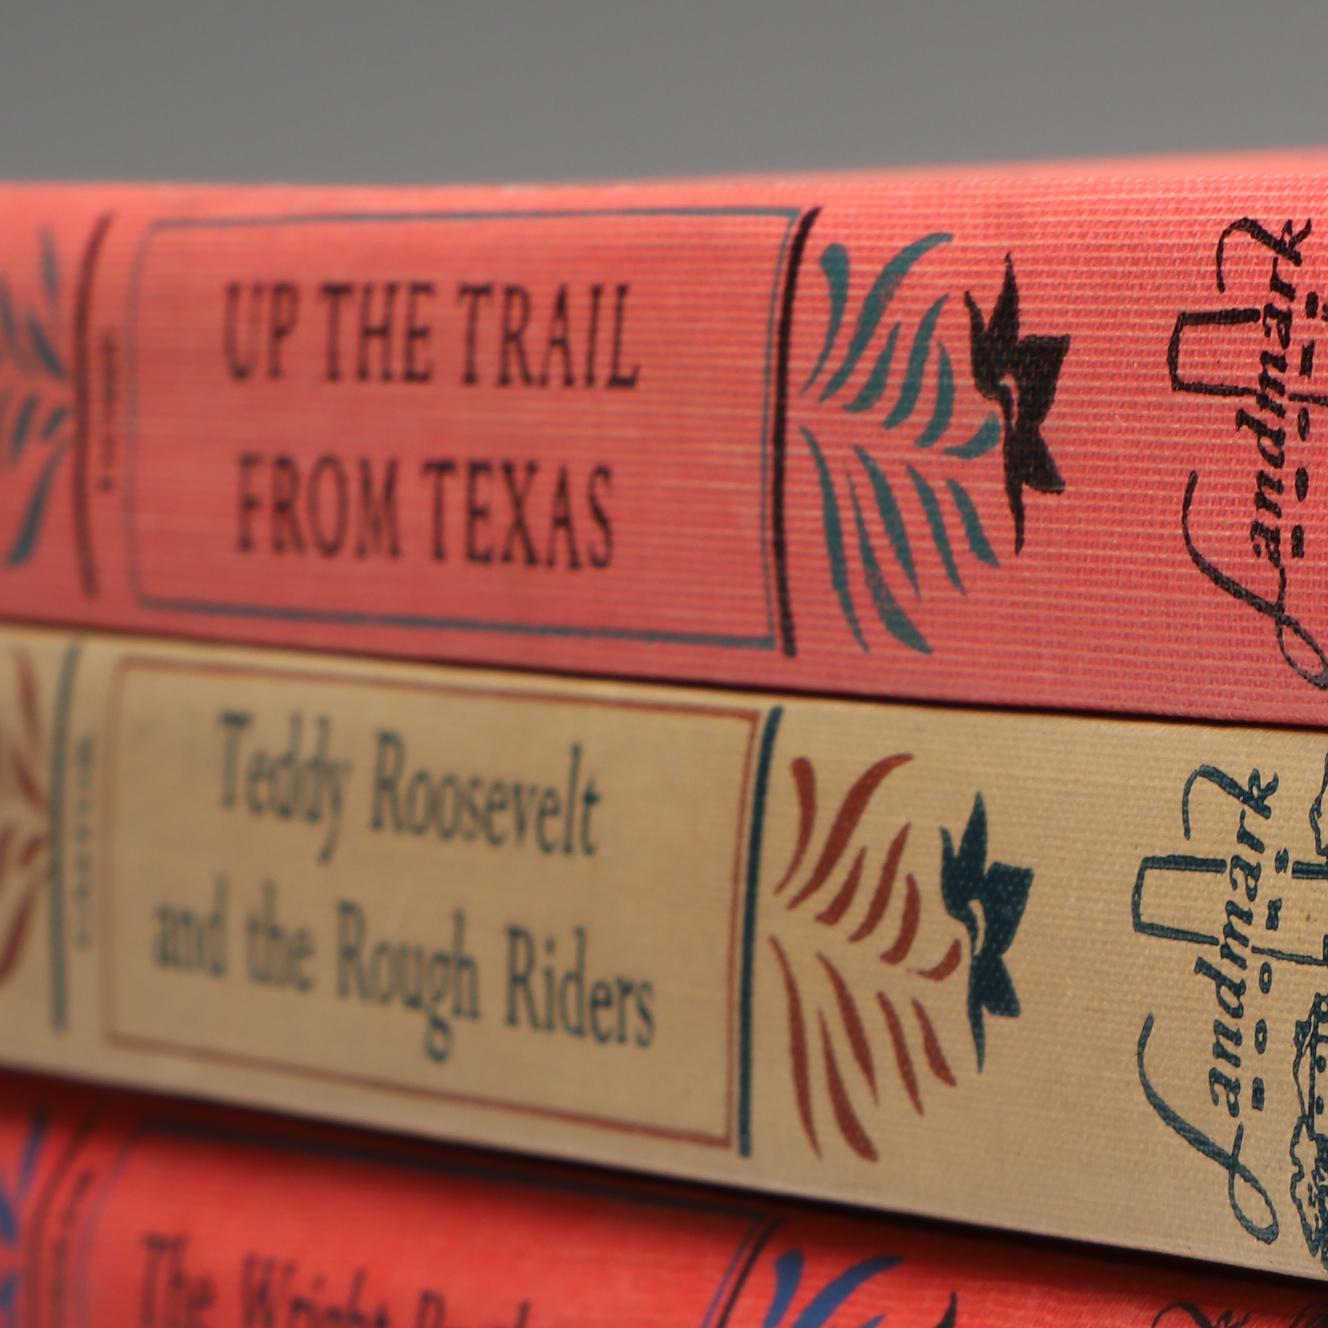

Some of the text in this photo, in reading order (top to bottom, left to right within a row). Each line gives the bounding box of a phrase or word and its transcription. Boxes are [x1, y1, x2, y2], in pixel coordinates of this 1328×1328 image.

[221, 281, 642, 390] UP THE TRAIL
[235, 452, 616, 571] FROM TEXAS
[217, 711, 353, 866] Teddy
[368, 729, 604, 857] Roosevelt
[151, 875, 657, 1064] and the Rough Riders
[1137, 764, 1279, 1245] Landmark
